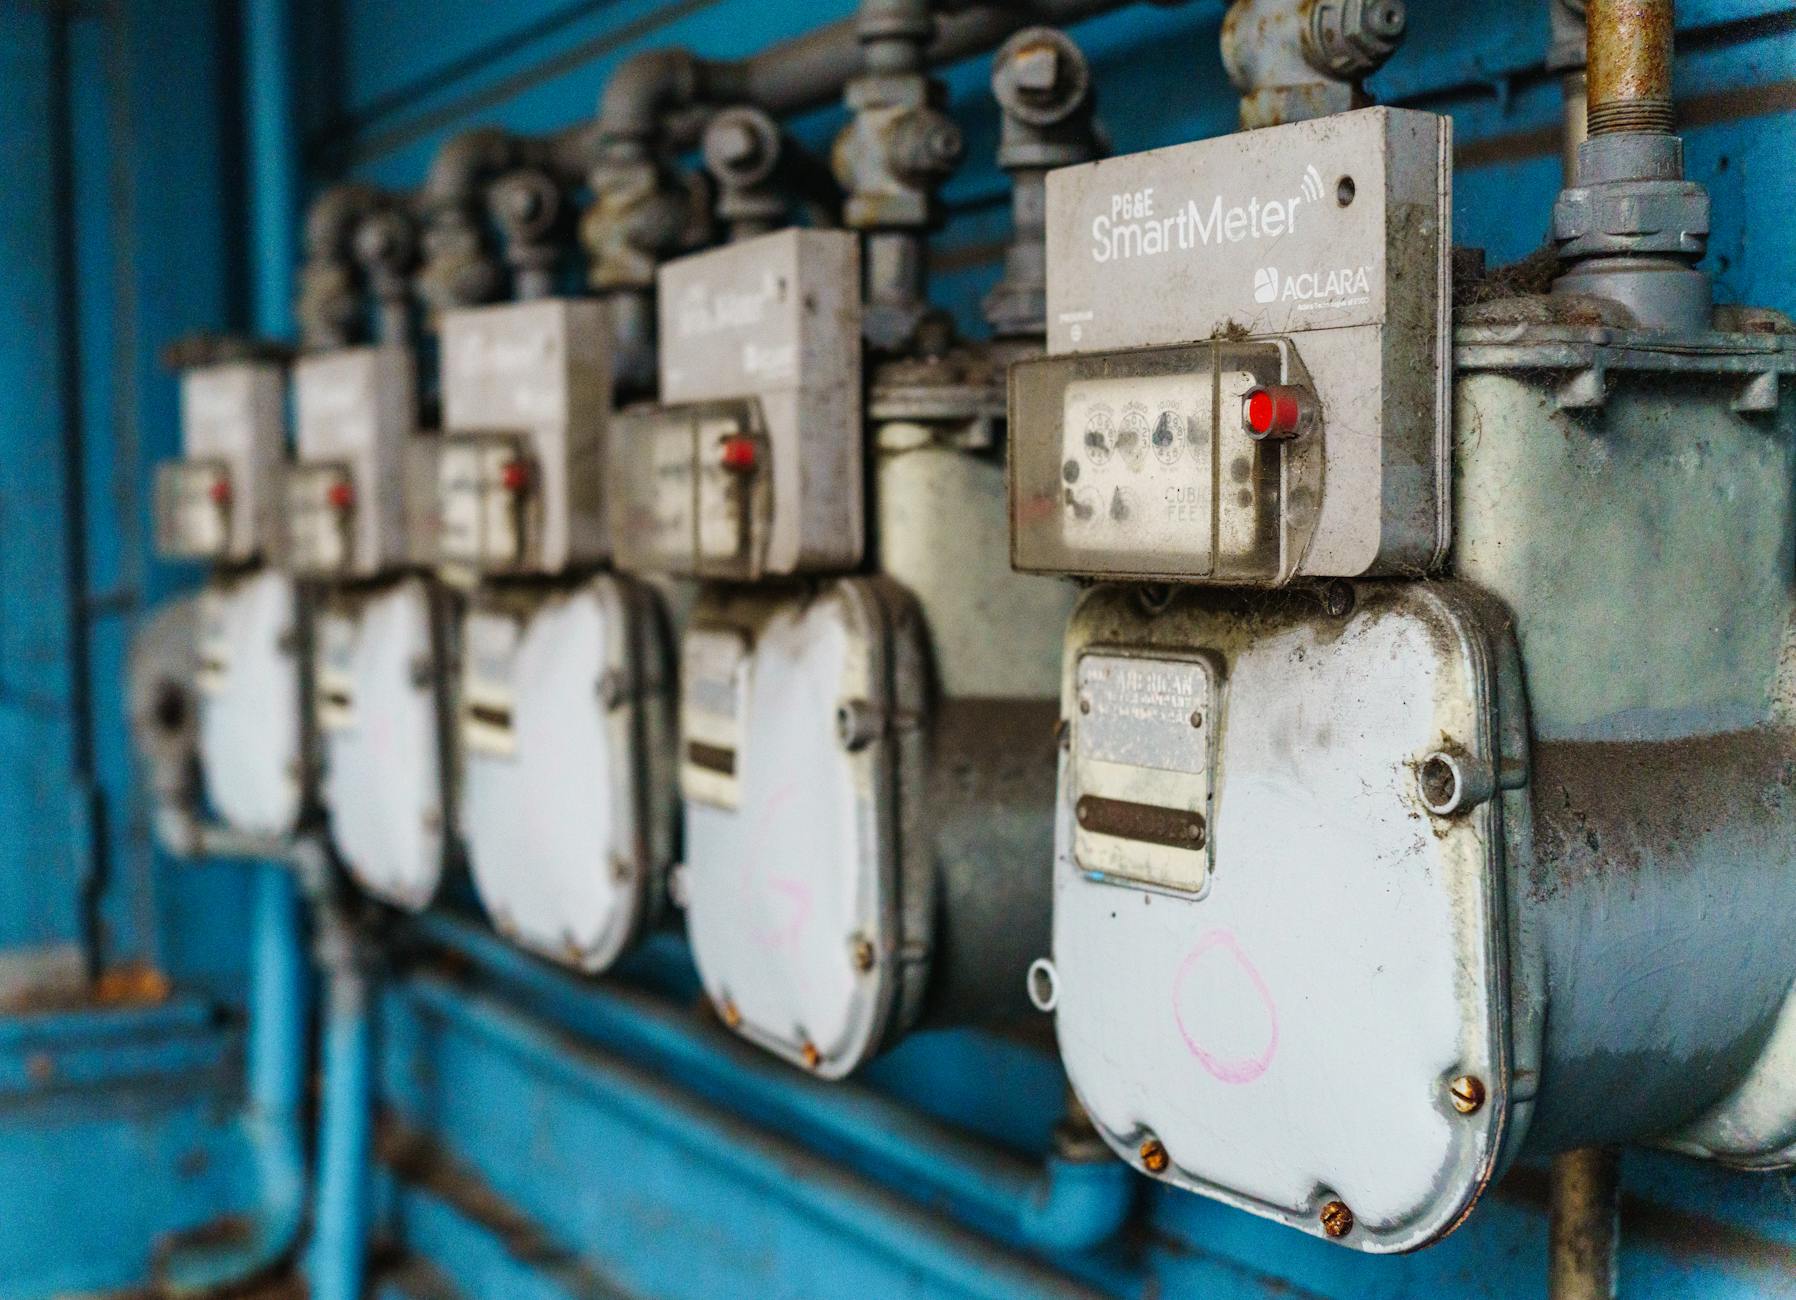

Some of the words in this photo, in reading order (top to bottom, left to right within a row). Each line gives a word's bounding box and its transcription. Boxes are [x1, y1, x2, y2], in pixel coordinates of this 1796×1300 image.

[1112, 188, 1154, 221] PG&E
[1092, 196, 1302, 264] SmartMeter
[1281, 266, 1370, 302] ACLARA
